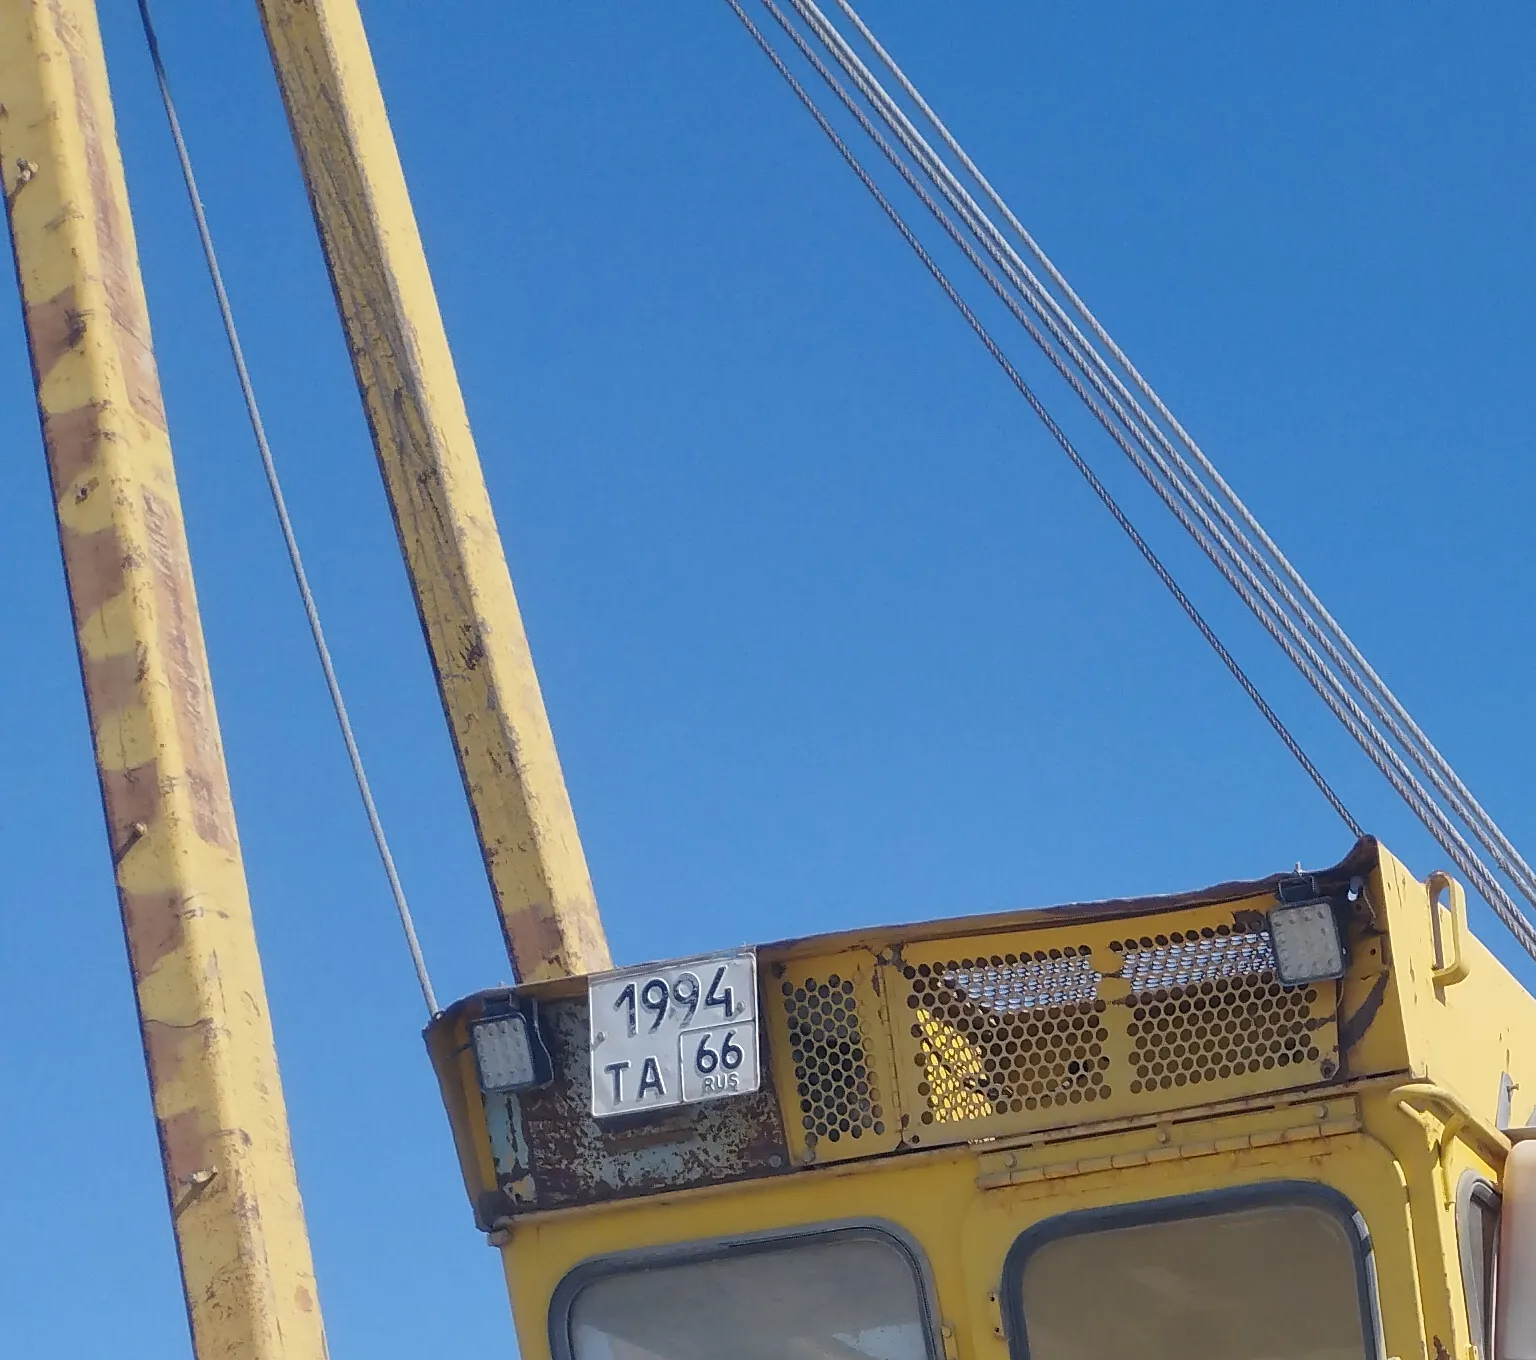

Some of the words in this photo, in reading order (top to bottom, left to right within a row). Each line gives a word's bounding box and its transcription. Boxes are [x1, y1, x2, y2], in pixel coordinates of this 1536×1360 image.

[613, 965, 736, 1037] 1994
[695, 1030, 744, 1074] 66
[702, 1073, 740, 1094] RUS
